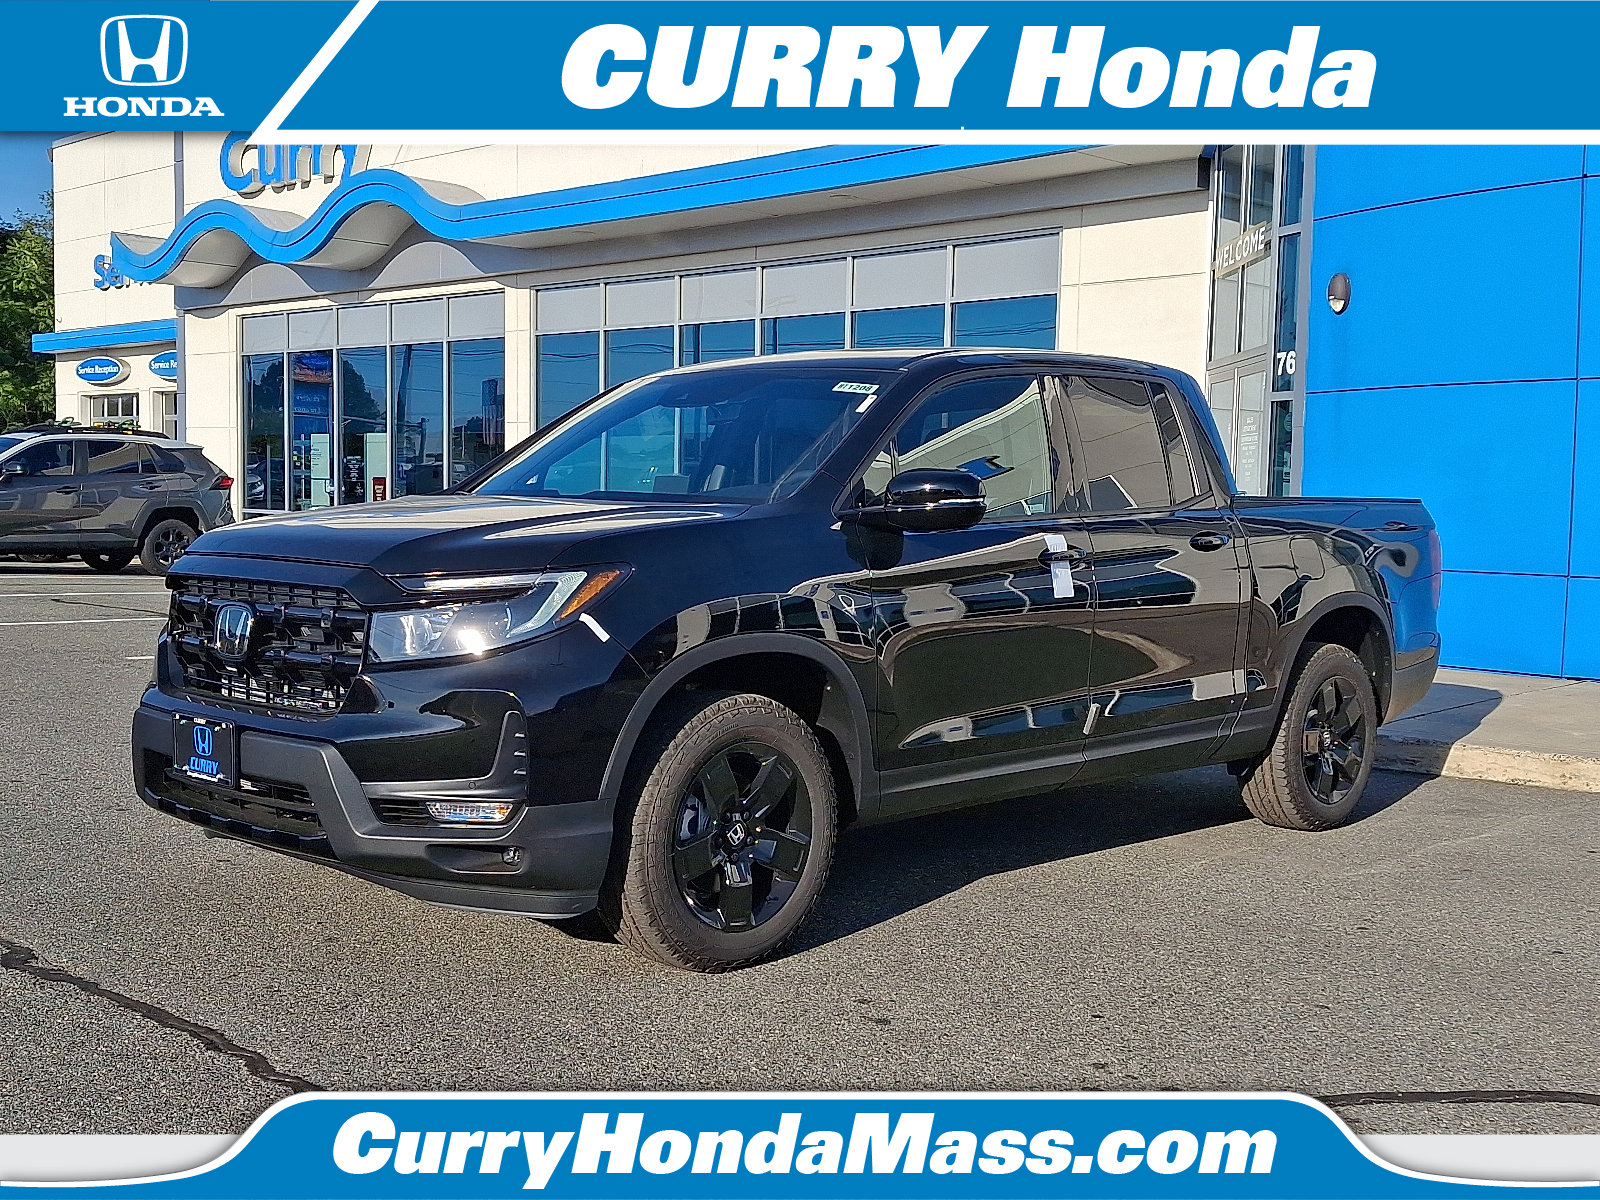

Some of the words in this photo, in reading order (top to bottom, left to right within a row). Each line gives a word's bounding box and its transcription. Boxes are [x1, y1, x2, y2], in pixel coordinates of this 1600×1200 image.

[1215, 226, 1266, 272] WELCOME
[77, 365, 95, 375] Service
[95, 364, 119, 375] Reception
[150, 360, 169, 370] Service
[1277, 350, 1297, 376] 76
[190, 756, 219, 775] CURRY
